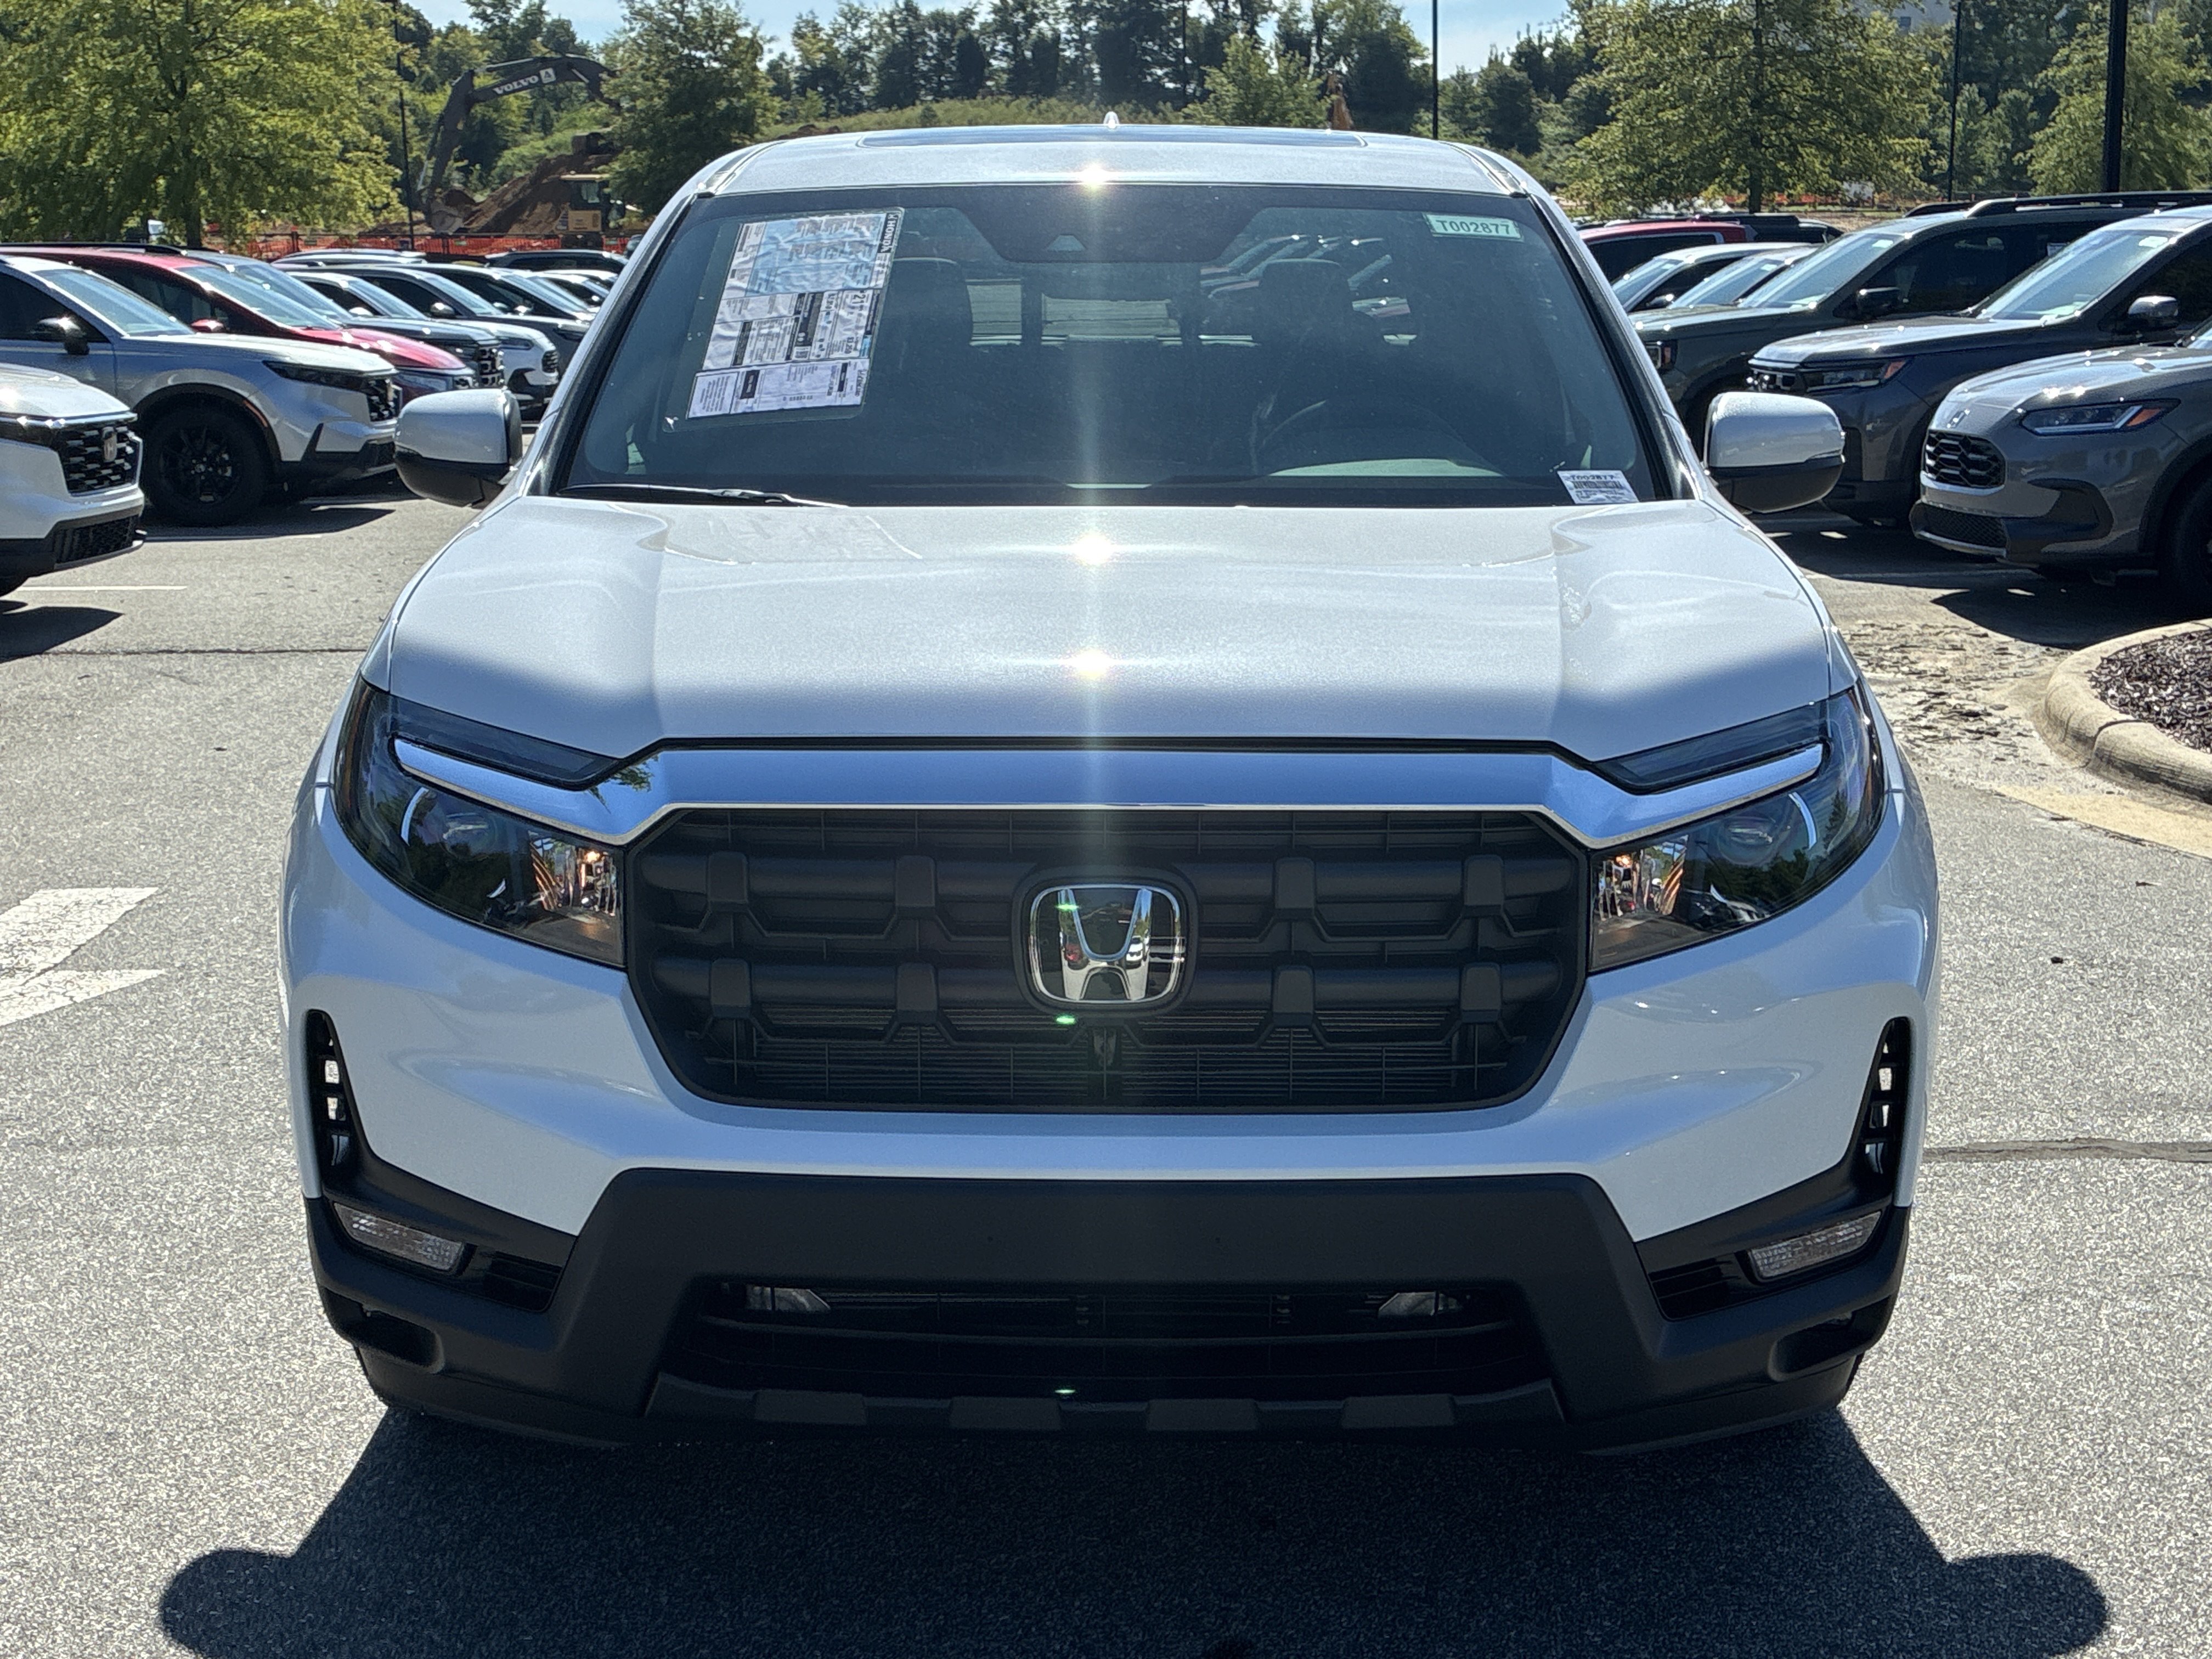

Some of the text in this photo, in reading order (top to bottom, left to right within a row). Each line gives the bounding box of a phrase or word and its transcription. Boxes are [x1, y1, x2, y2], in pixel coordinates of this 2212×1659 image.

[493, 75, 539, 94] VOLVO
[881, 220, 896, 252] HONDA
[1436, 219, 1510, 235] T002877
